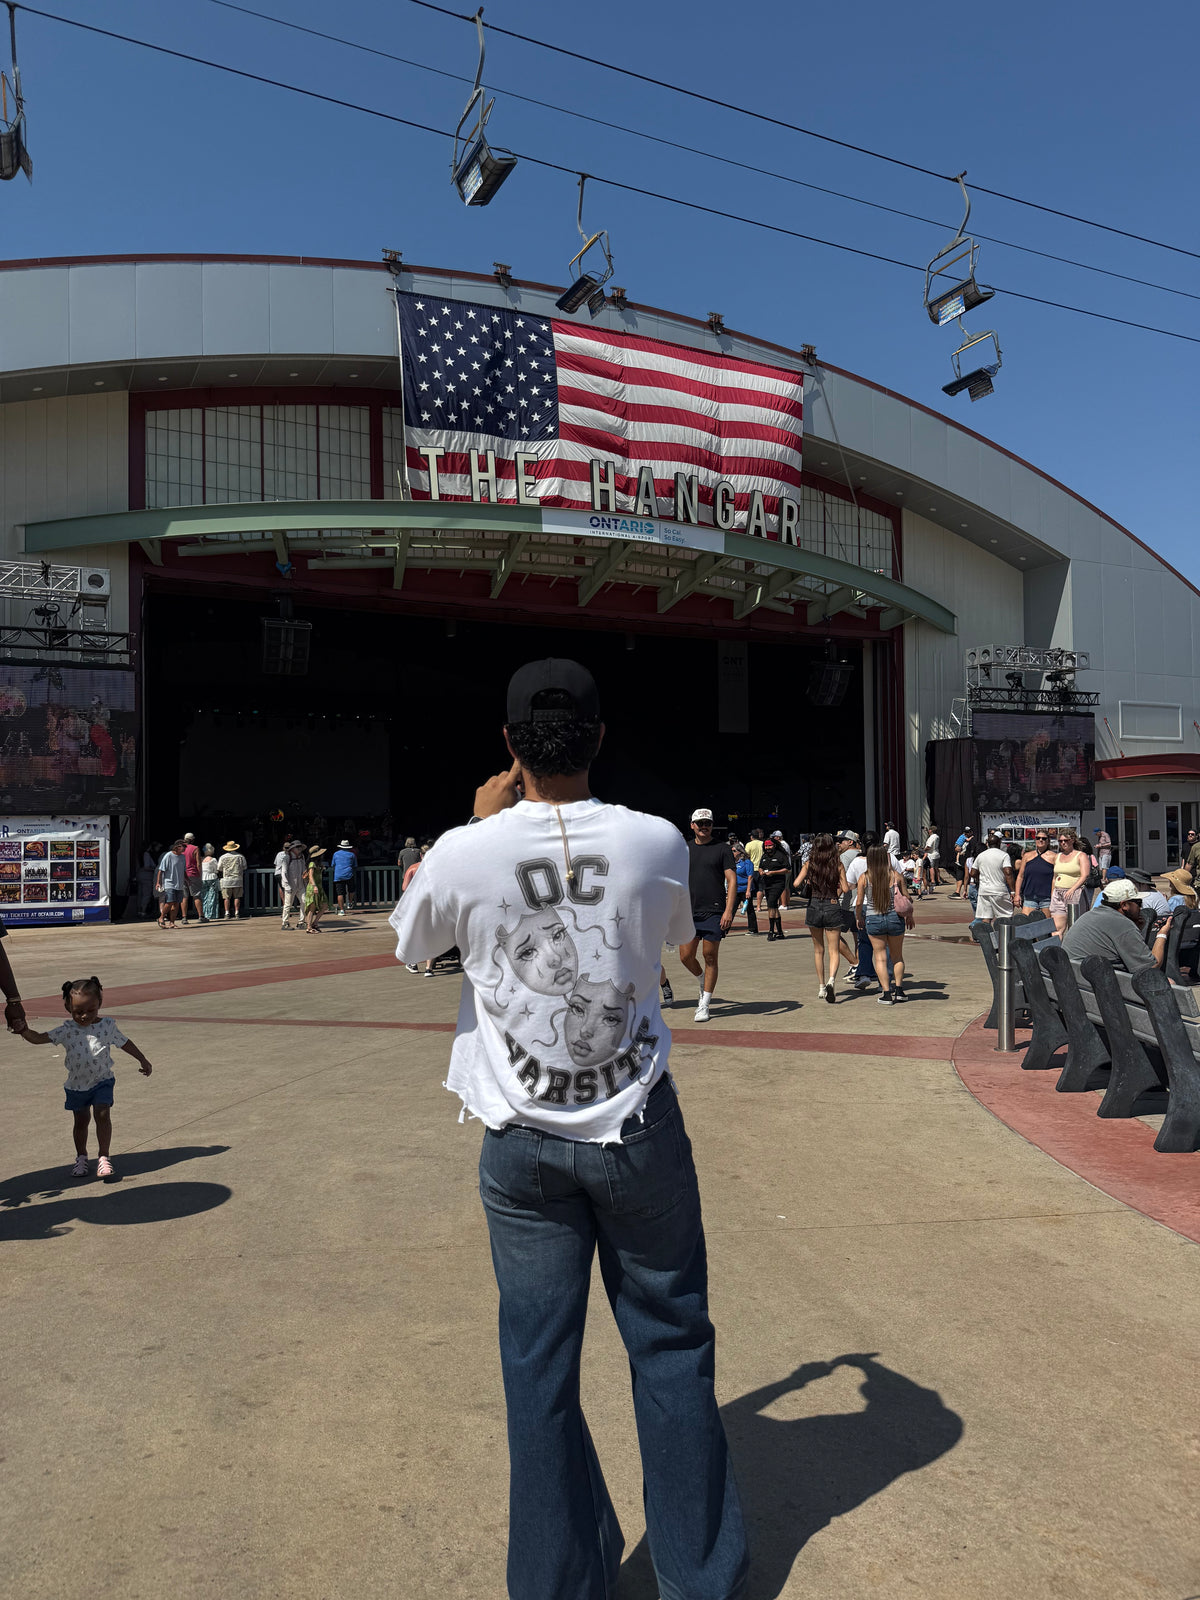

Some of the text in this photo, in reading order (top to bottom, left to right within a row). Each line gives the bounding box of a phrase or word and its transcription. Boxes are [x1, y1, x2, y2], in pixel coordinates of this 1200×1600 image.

[418, 446, 800, 546] THE HANGAR
[589, 516, 655, 534] ONTARIO
[515, 854, 609, 910] OC
[504, 1015, 659, 1105] VARSITY
